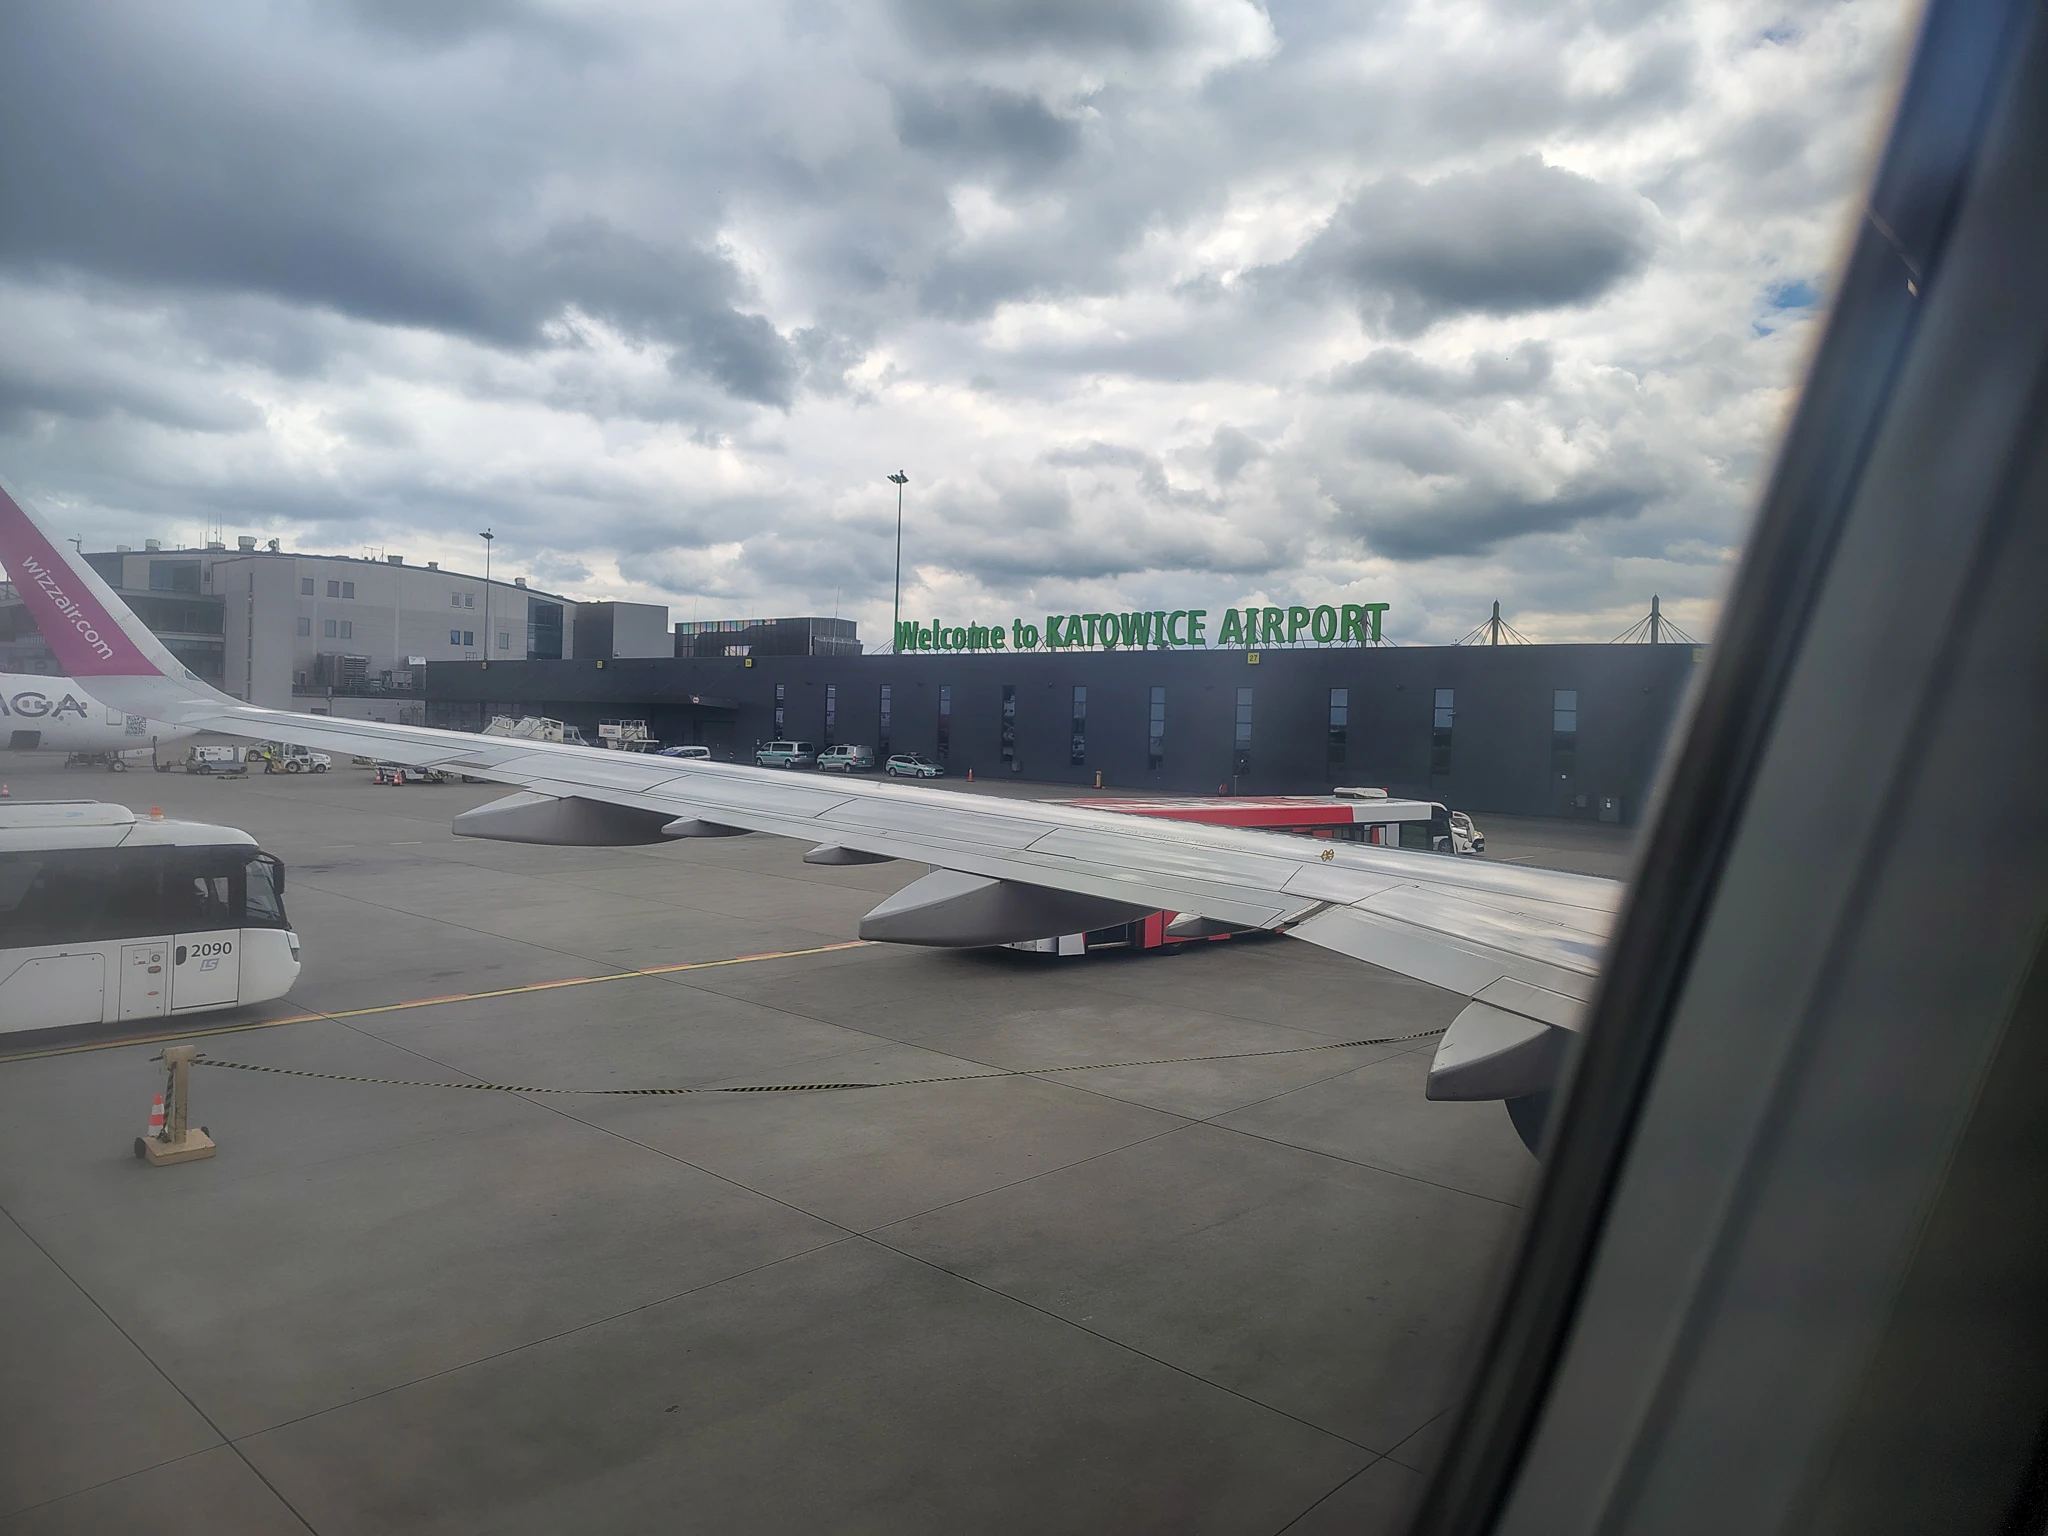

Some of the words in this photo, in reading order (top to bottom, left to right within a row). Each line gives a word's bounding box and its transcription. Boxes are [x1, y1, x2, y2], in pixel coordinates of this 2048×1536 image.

[22, 556, 113, 660] wizzair.com
[896, 619, 1005, 650] Welcome
[1012, 619, 1039, 648] to
[1047, 610, 1207, 648] KATOWICE
[1218, 603, 1390, 645] AIRPORT
[191, 941, 232, 957] 2090
